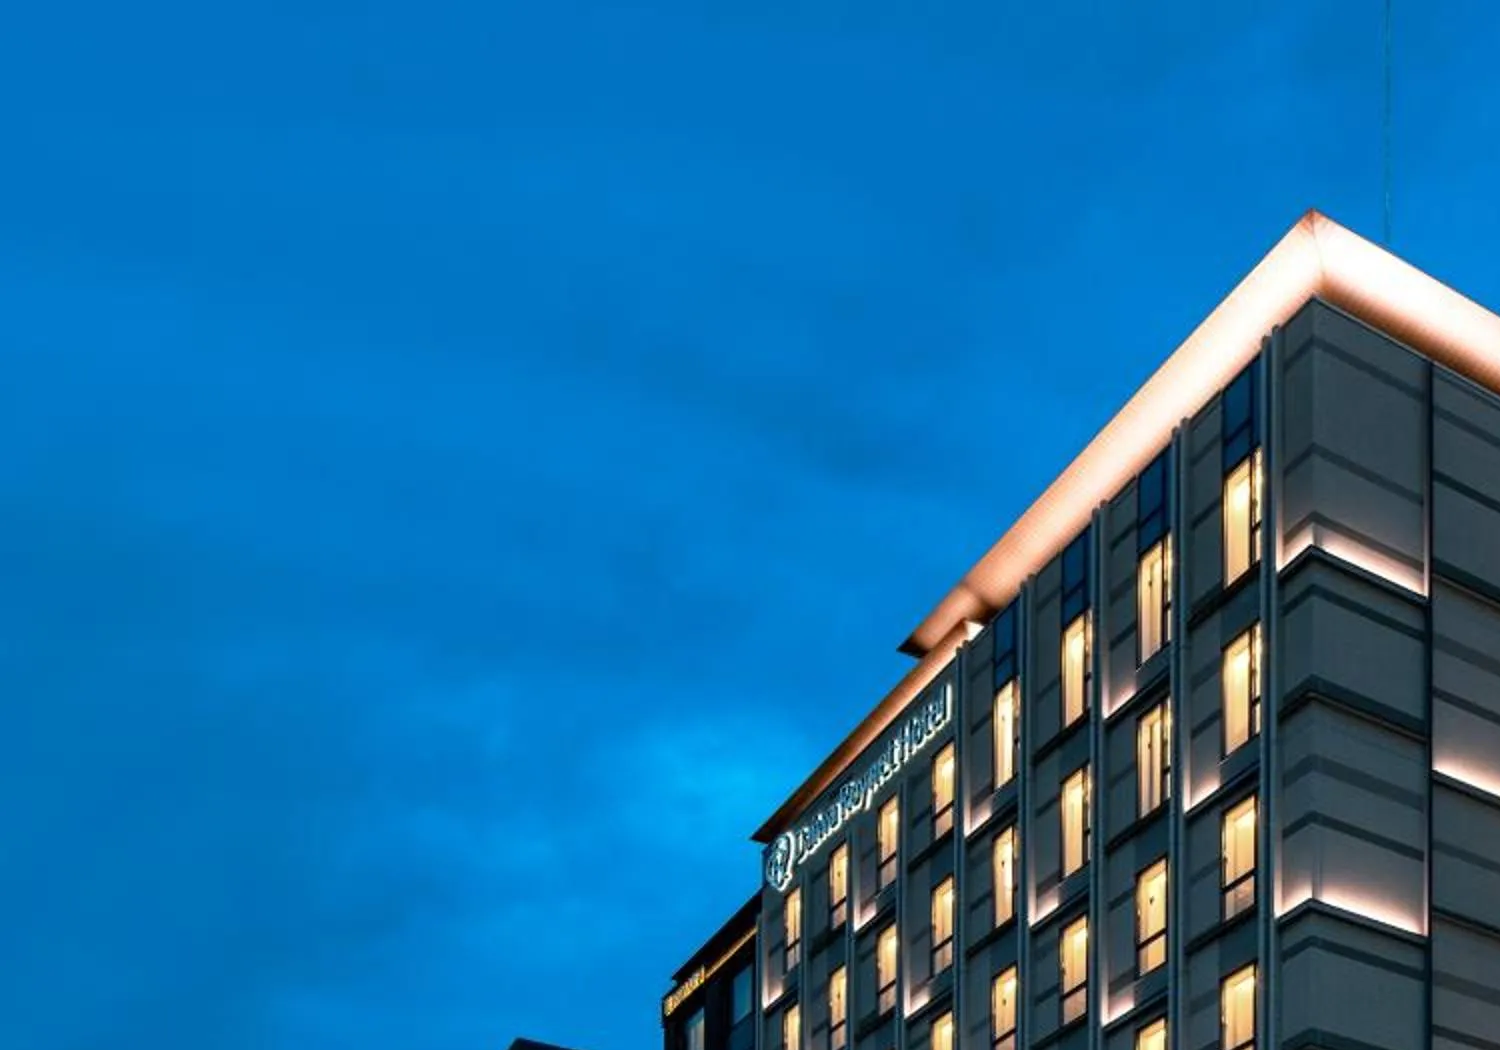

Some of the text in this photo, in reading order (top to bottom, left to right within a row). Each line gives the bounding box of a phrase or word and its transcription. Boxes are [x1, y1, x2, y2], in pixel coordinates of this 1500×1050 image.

[798, 683, 952, 865] Daiwa Roynet Hotel
